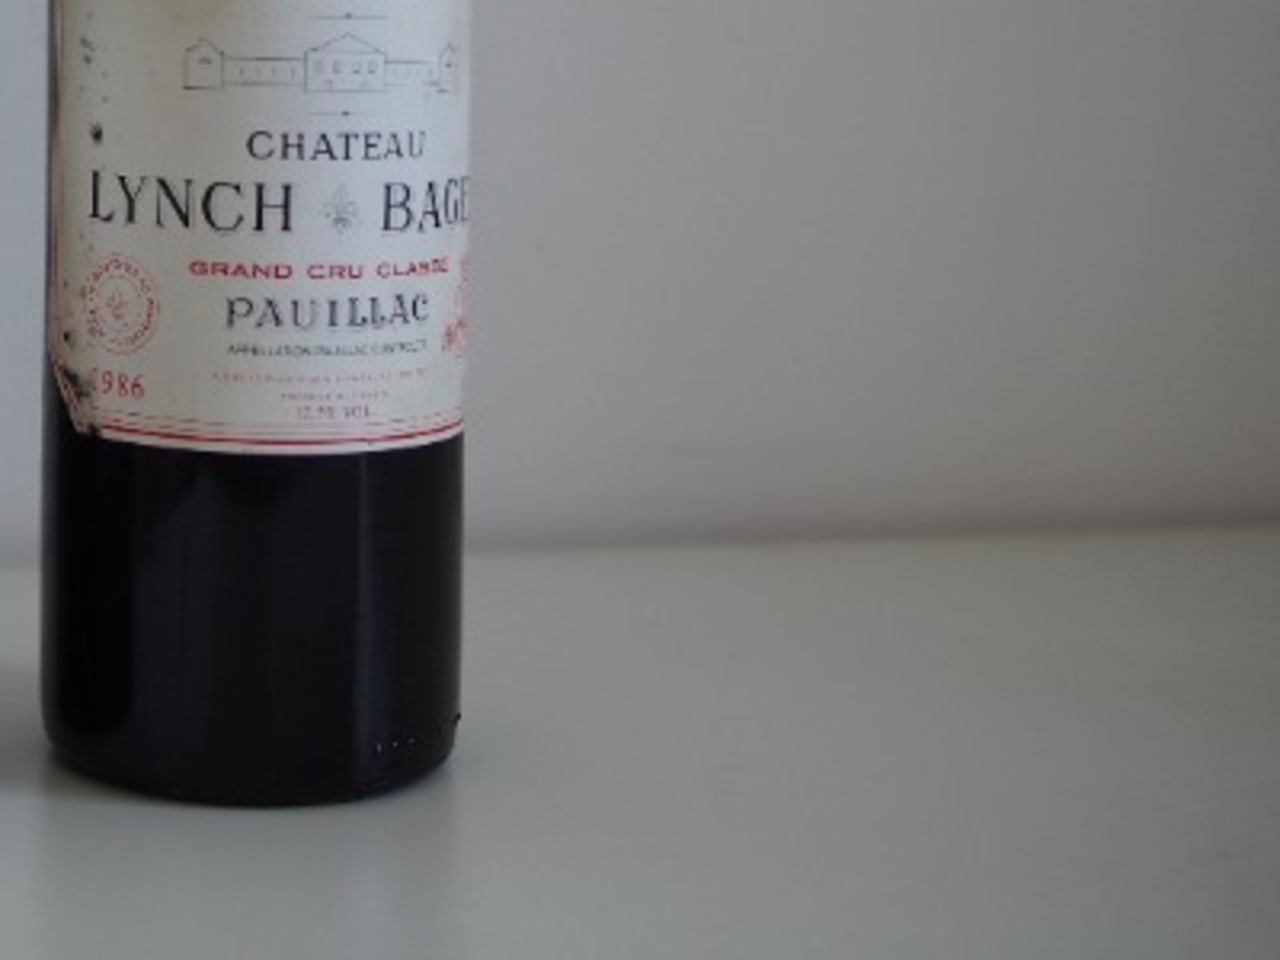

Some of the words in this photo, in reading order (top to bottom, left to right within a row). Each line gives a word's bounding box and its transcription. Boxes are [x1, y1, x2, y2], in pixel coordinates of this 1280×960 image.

[246, 130, 427, 162] CHATEAU
[88, 171, 293, 233] LYNCH
[188, 260, 293, 280] GRAND
[306, 261, 364, 280] CRU
[226, 292, 430, 330] PAUILLAC
